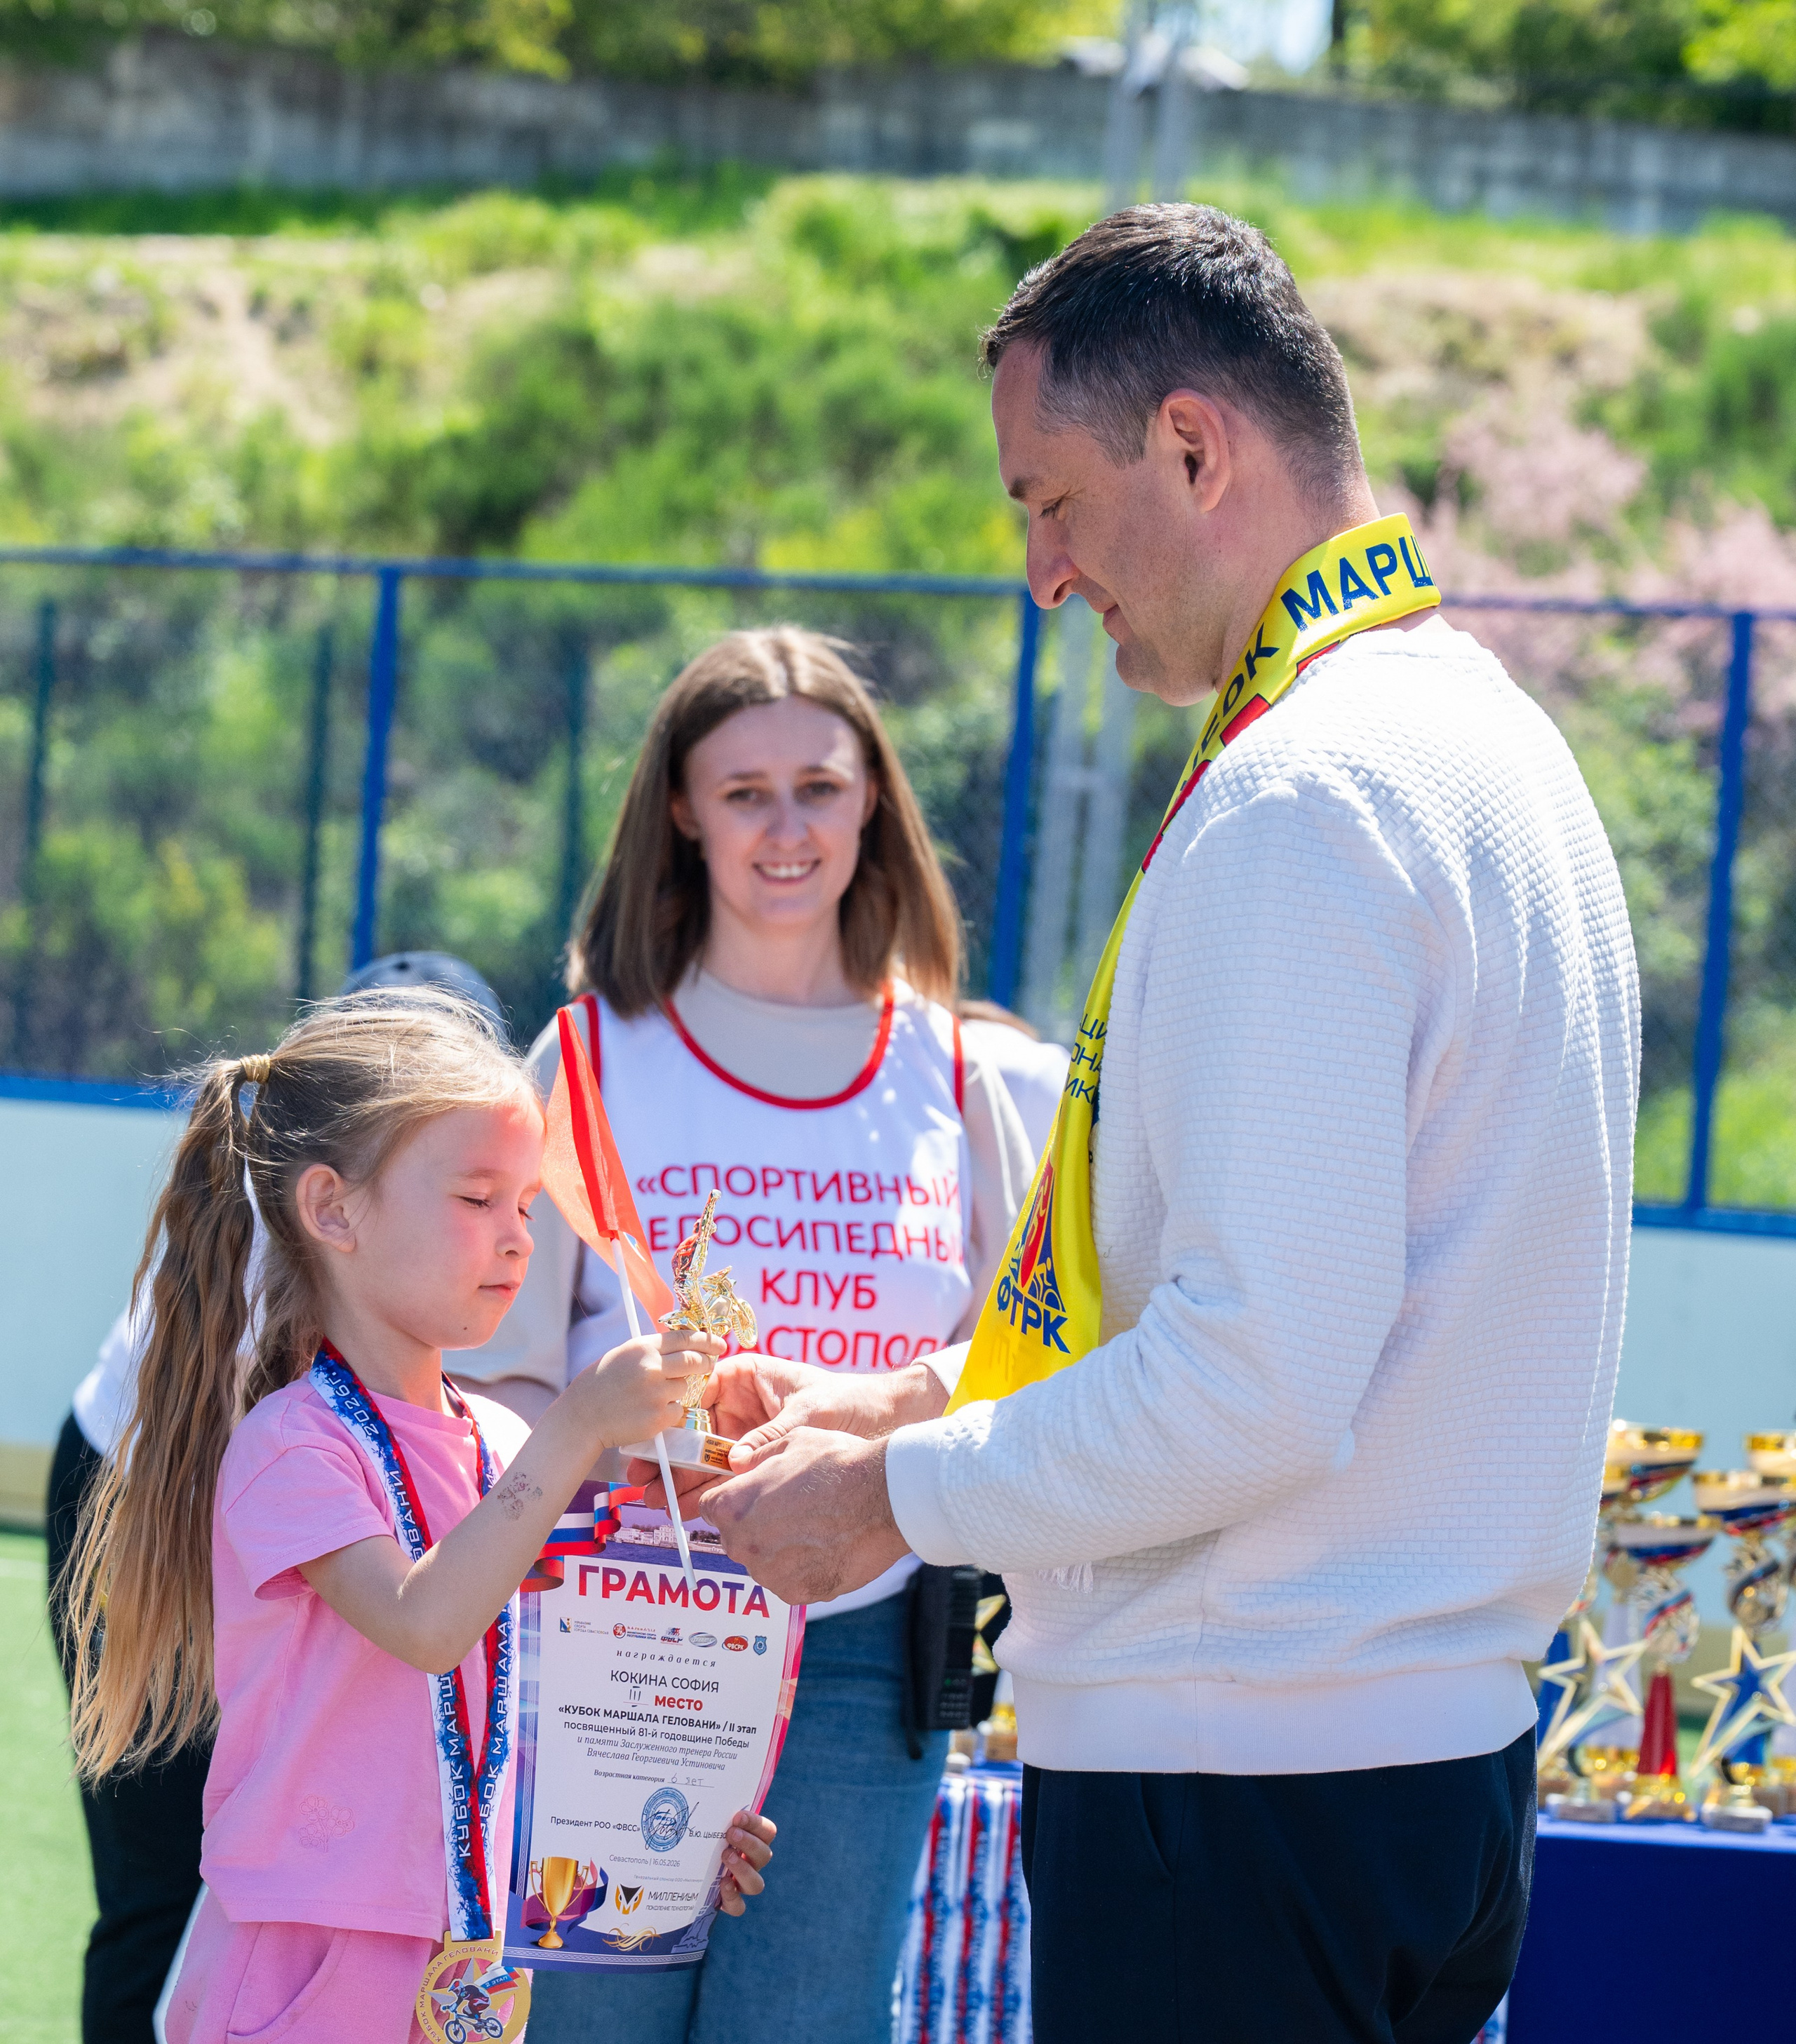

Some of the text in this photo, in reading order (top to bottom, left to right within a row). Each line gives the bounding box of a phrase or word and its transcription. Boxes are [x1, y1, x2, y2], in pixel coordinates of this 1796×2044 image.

[760, 1268, 878, 1311] КЛУБ
[997, 1275, 1071, 1354] ФТРК
[578, 1564, 770, 1618] ГРАМОТА
[617, 1650, 716, 1667] награждается
[492, 1620, 509, 1755] МАРШАЛА
[610, 1669, 719, 1693] КОКИНА СОФИЯ
[655, 1695, 704, 1711] место
[558, 1705, 601, 1717] «КУБОК
[603, 1709, 659, 1723] МАРШАЛА
[662, 1715, 721, 1730] ГЕЛОВАНИ»
[564, 1721, 749, 1749] посвященный 81-й годовщине Победы
[584, 1736, 619, 1747] памяти
[620, 1739, 678, 1754] Заслуженного
[679, 1747, 712, 1759] тренера
[713, 1749, 737, 1760] России
[587, 1747, 725, 1770] Вячеслава Георгиевича Устиновича
[594, 1769, 665, 1783] Возрастная категория
[449, 1763, 472, 1859] КУБОК
[550, 1816, 641, 1832] Президент РОО «ФВСС»
[609, 1855, 649, 1865] Севастополь
[652, 1858, 681, 1867] 16.05.2026
[648, 1891, 699, 1902] МИЛЛЕНИУМ
[492, 1976, 508, 1985] ЭТАП
[420, 1946, 499, 2043] КУБОК МАРШАЛА ГЕЛОВАНИ
